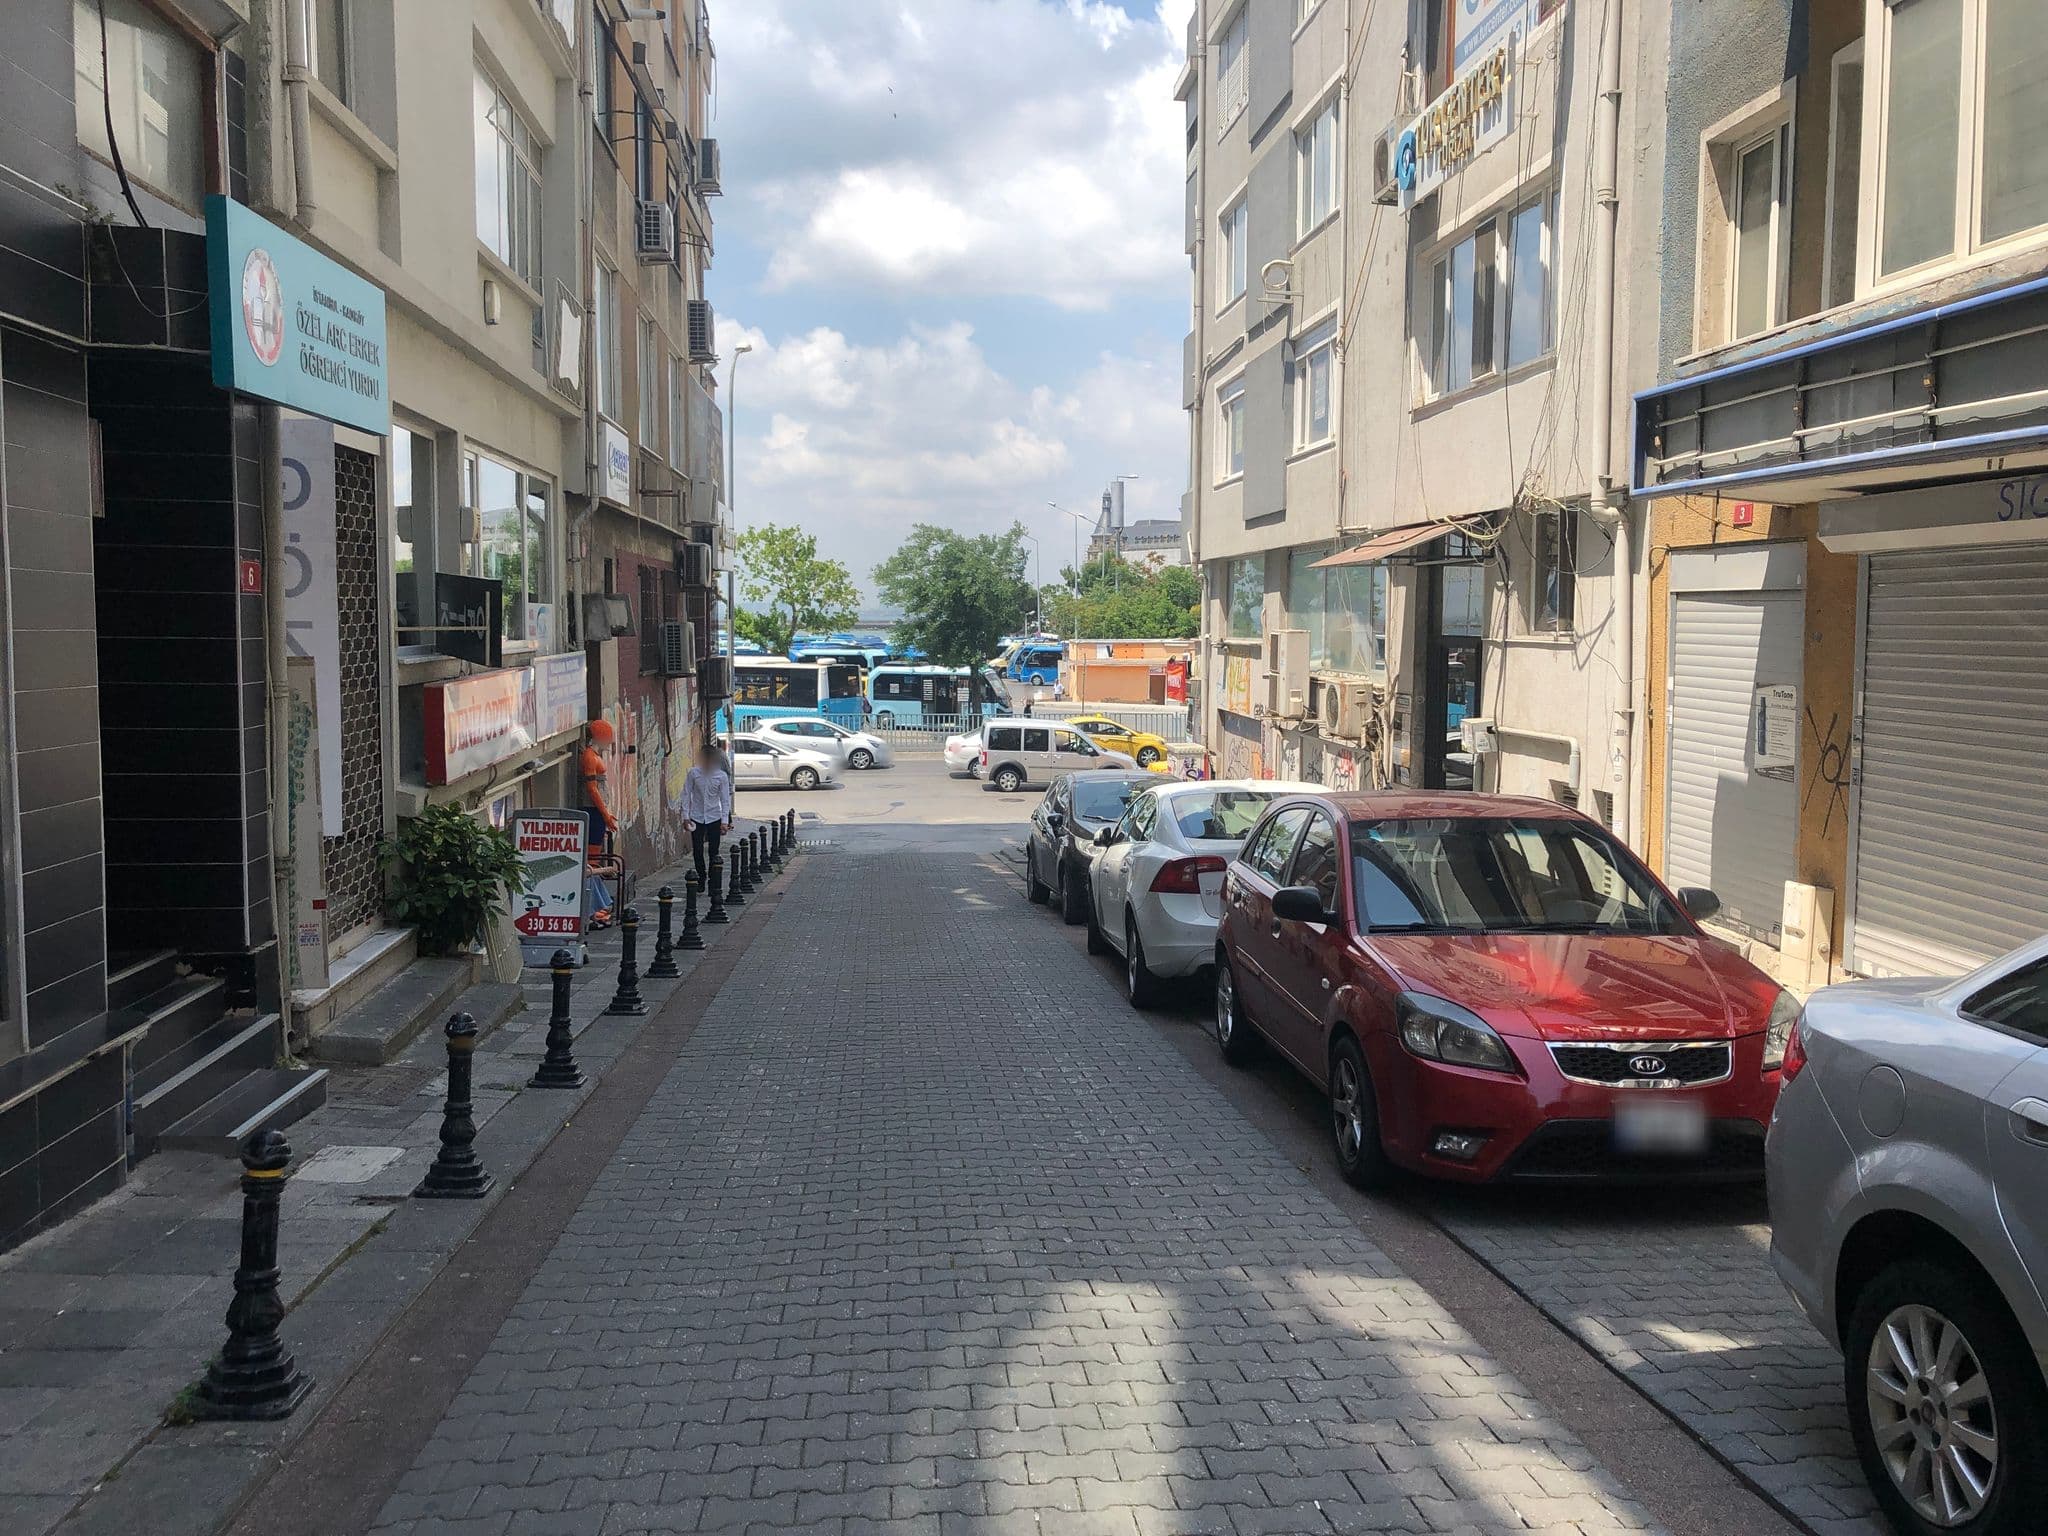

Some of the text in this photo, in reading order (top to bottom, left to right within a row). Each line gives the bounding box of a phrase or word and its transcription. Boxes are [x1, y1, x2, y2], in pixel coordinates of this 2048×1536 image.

[295, 300, 326, 342] ÖZEL
[348, 332, 381, 367] ERKEK
[299, 342, 380, 400] ÖĞRENCİ YURDU
[1738, 506, 1746, 520] 3
[247, 567, 255, 587] 6
[521, 821, 579, 835] YILDIRIM
[519, 836, 581, 852] MEDİKAL
[527, 918, 574, 931] 330 56 86
[1634, 1059, 1660, 1071] KIA
